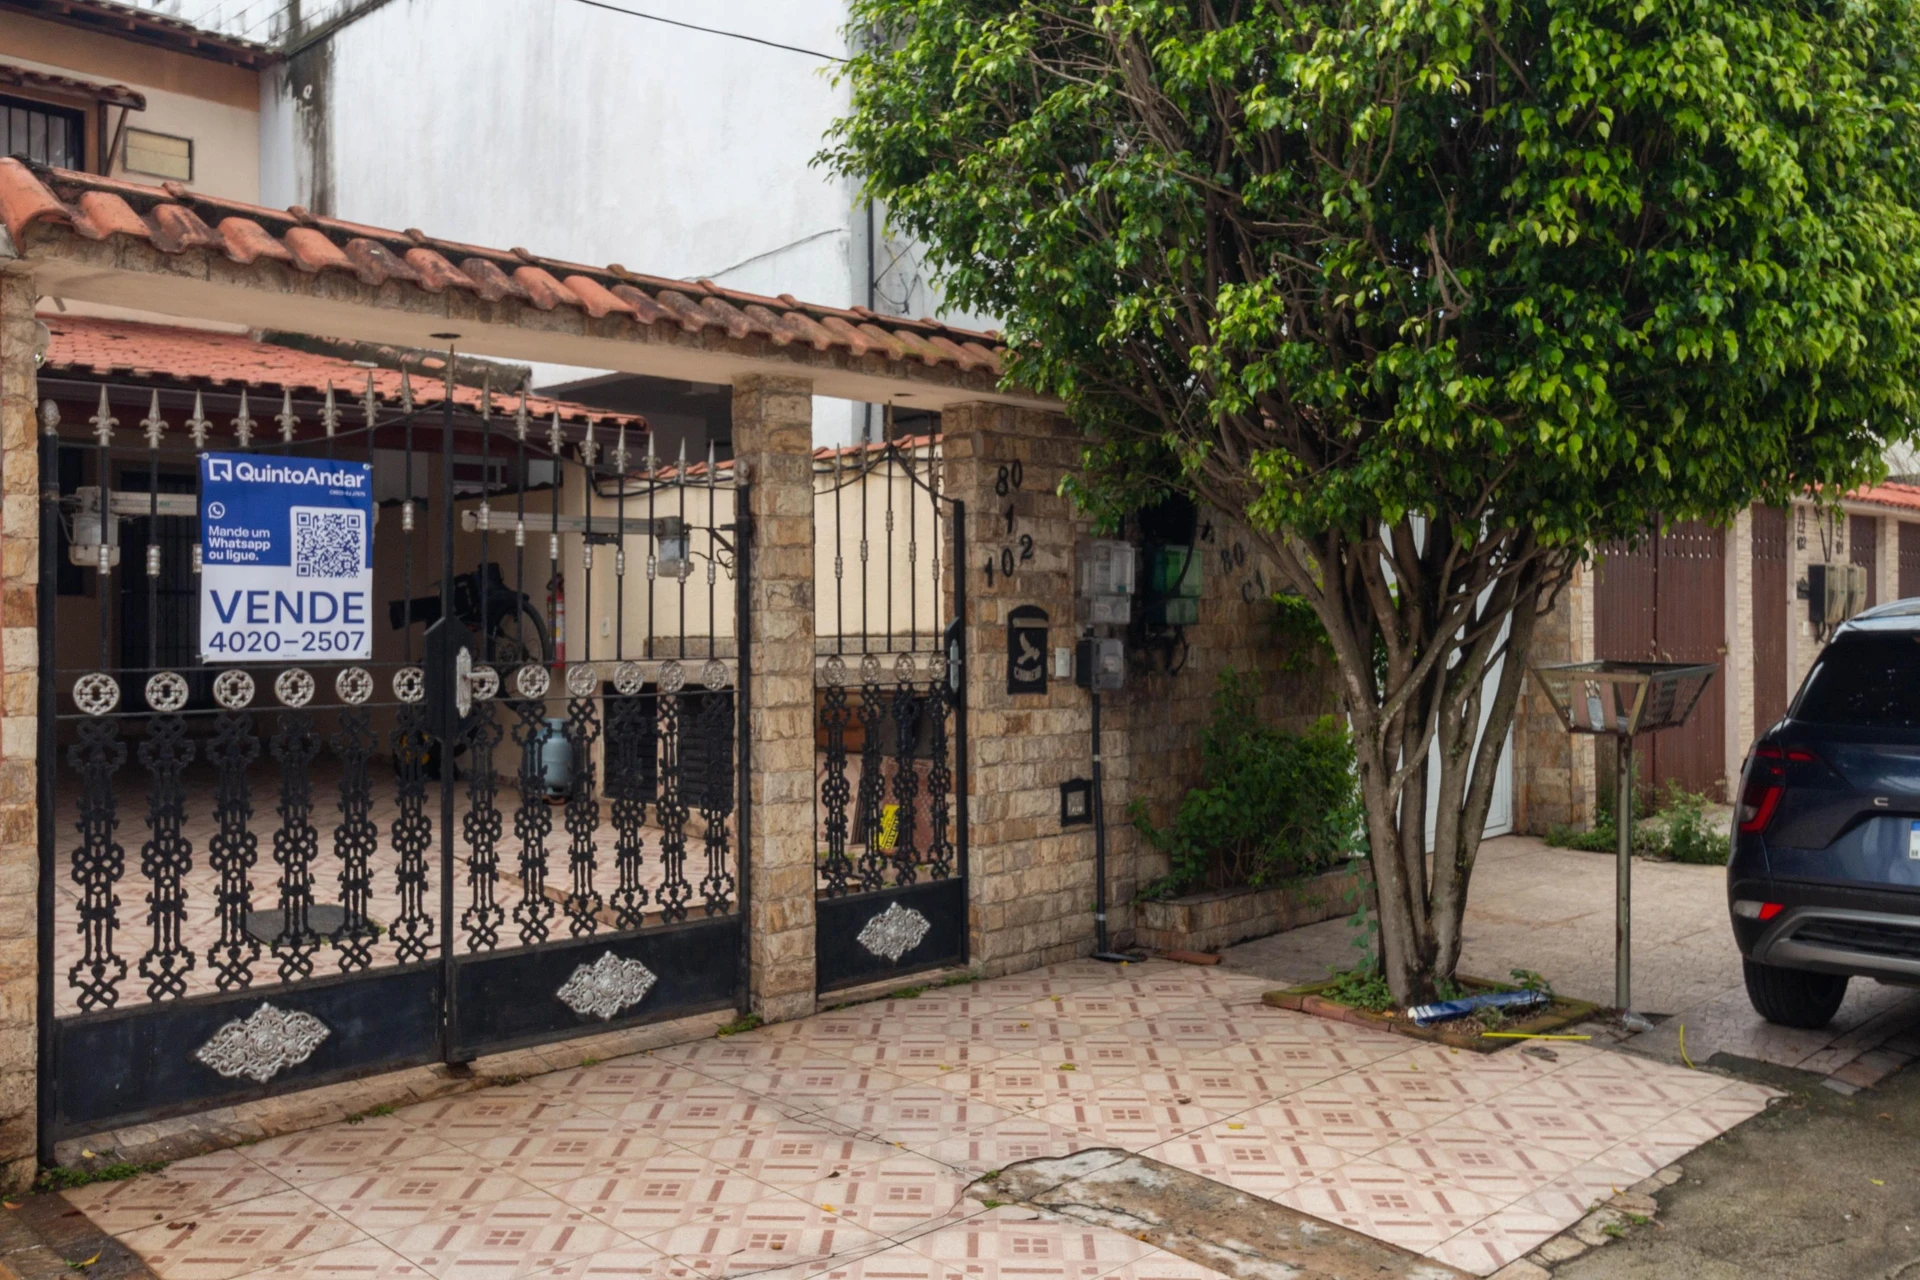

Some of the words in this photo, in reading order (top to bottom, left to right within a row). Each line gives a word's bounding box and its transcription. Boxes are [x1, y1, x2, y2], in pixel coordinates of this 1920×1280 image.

[236, 462, 365, 488] QuintoAndar
[995, 459, 1023, 496] 80
[208, 526, 249, 538] Mande
[251, 528, 270, 538] um
[208, 538, 271, 551] Whatsapp
[208, 551, 224, 560] ou
[226, 550, 259, 562] ligue.
[984, 534, 1033, 588] 102
[209, 590, 365, 624] VENDE
[208, 631, 365, 652] 4020-2507
